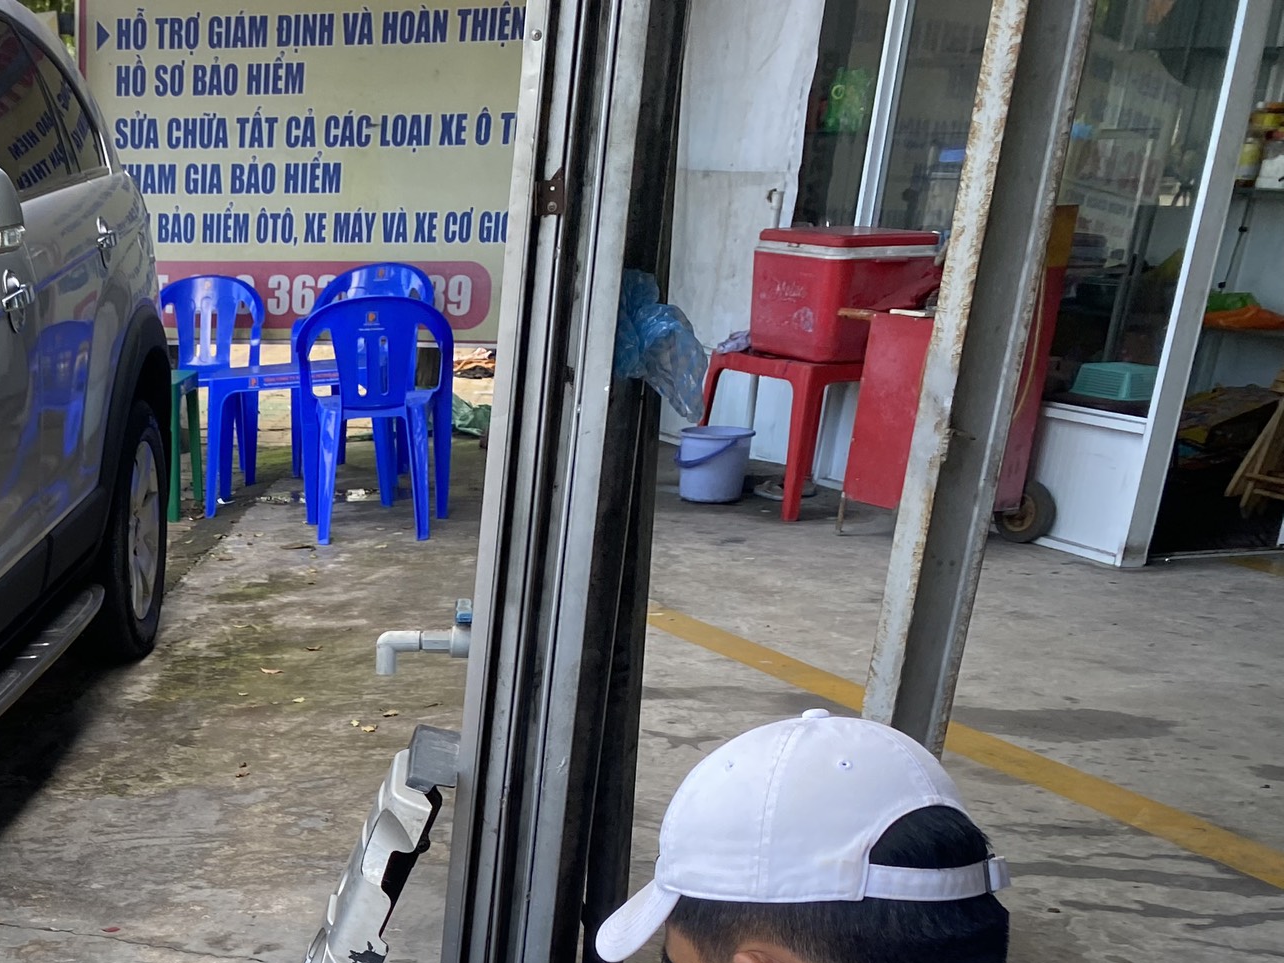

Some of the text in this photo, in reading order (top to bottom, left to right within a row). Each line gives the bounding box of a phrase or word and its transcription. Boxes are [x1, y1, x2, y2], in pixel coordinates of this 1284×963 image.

[117, 8, 147, 50] HỖ
[155, 12, 200, 55] TRỢ
[208, 11, 268, 48] GIÁM
[276, 13, 334, 53] ĐỊNH
[343, 7, 373, 45] VÀ
[382, 5, 448, 44] HOÀN
[116, 54, 147, 97] HỒ
[154, 60, 185, 97] SƠ
[192, 56, 238, 96] BẢO
[247, 51, 304, 95] HIỂM
[115, 110, 159, 149] SỬA
[167, 112, 228, 149] CHỮA
[236, 106, 278, 148] TẤT
[285, 108, 316, 148] CẢ
[324, 110, 371, 147] CÁC
[380, 114, 432, 152] LOẠI
[439, 113, 467, 146] XE
[475, 107, 492, 145] Ô
[501, 112, 516, 144] T
[185, 163, 222, 195] GIA
[231, 155, 276, 194] BẢO
[284, 151, 341, 194] HIỂM
[158, 205, 195, 243] BẢO
[202, 202, 249, 243] HIỂM
[256, 207, 298, 246] ÔTÔ,
[304, 213, 327, 243] XE
[333, 207, 376, 243] MÁY
[383, 207, 407, 243] VÀ
[413, 212, 437, 243] XE
[444, 207, 473, 243] CƠ
